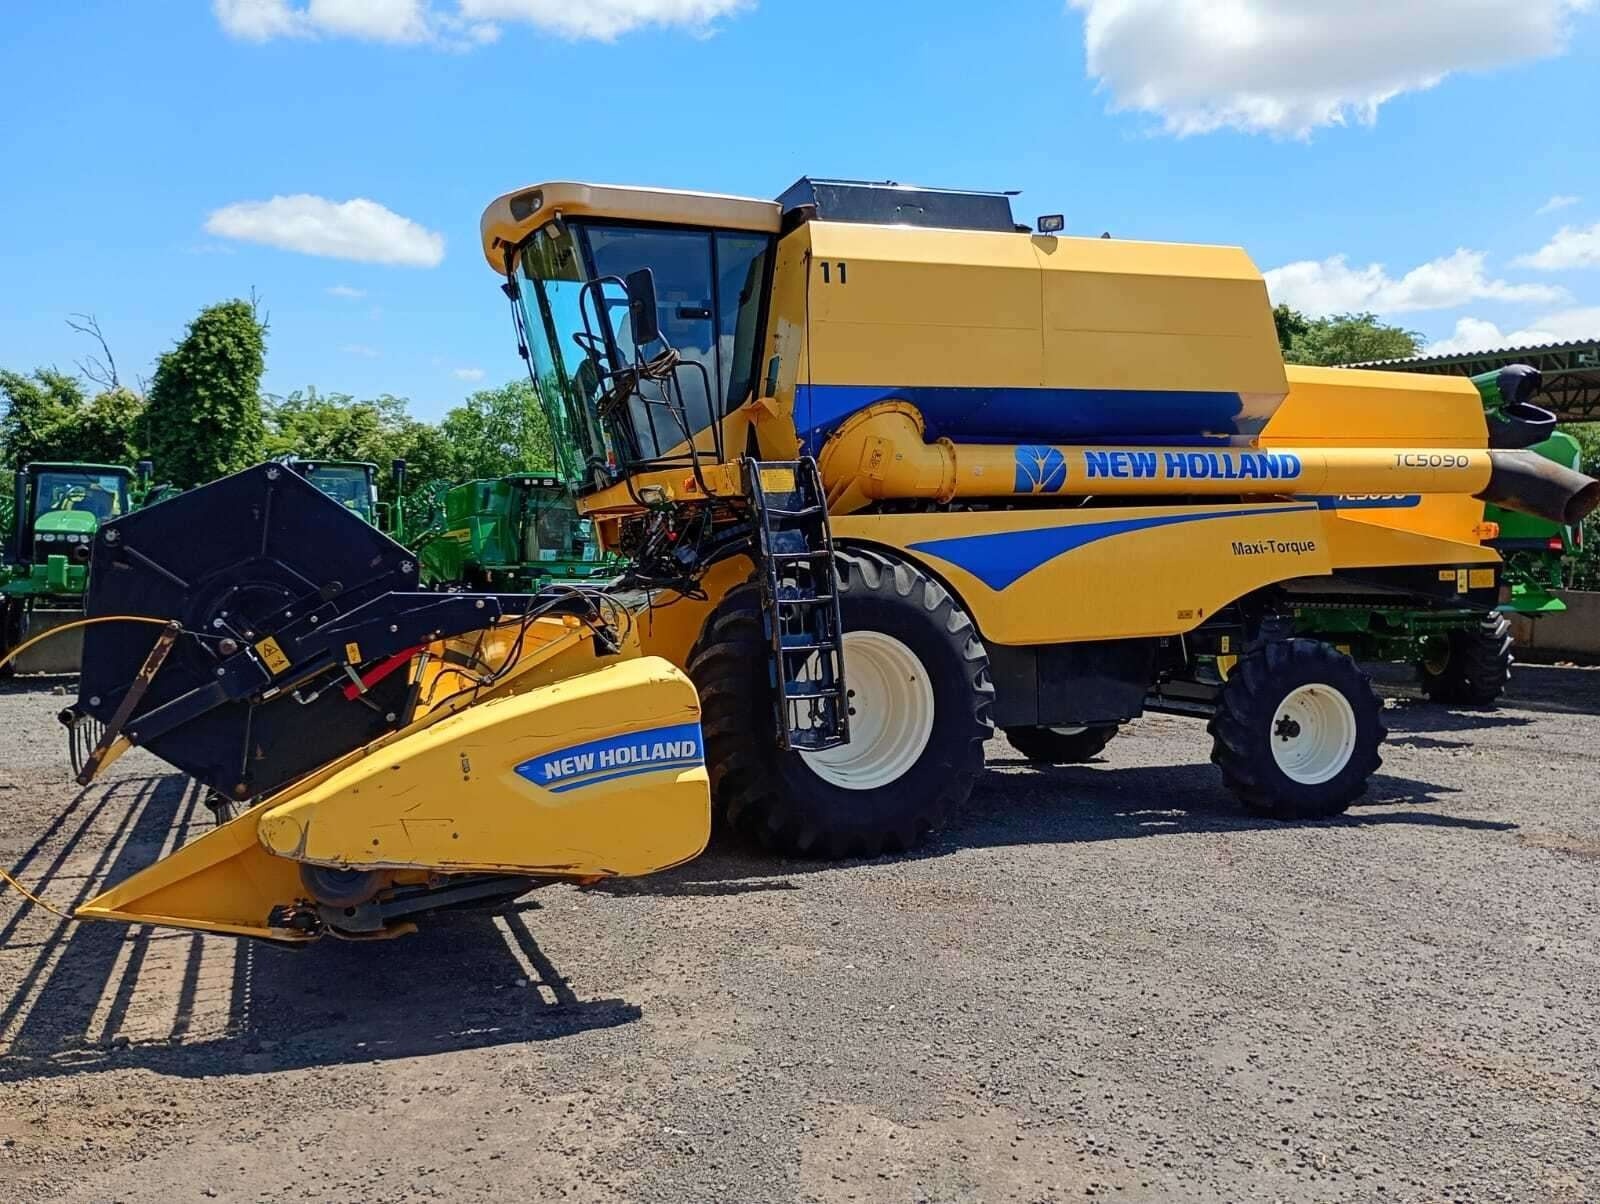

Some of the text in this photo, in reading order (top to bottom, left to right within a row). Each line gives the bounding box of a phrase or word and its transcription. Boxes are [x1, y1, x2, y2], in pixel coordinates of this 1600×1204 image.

[820, 261, 846, 284] 11
[1084, 450, 1301, 479] NEW HOLLAND
[1394, 453, 1470, 468] TC5090
[1231, 540, 1316, 556] Maxi-Torque
[544, 740, 697, 779] NEW HOLLAND
